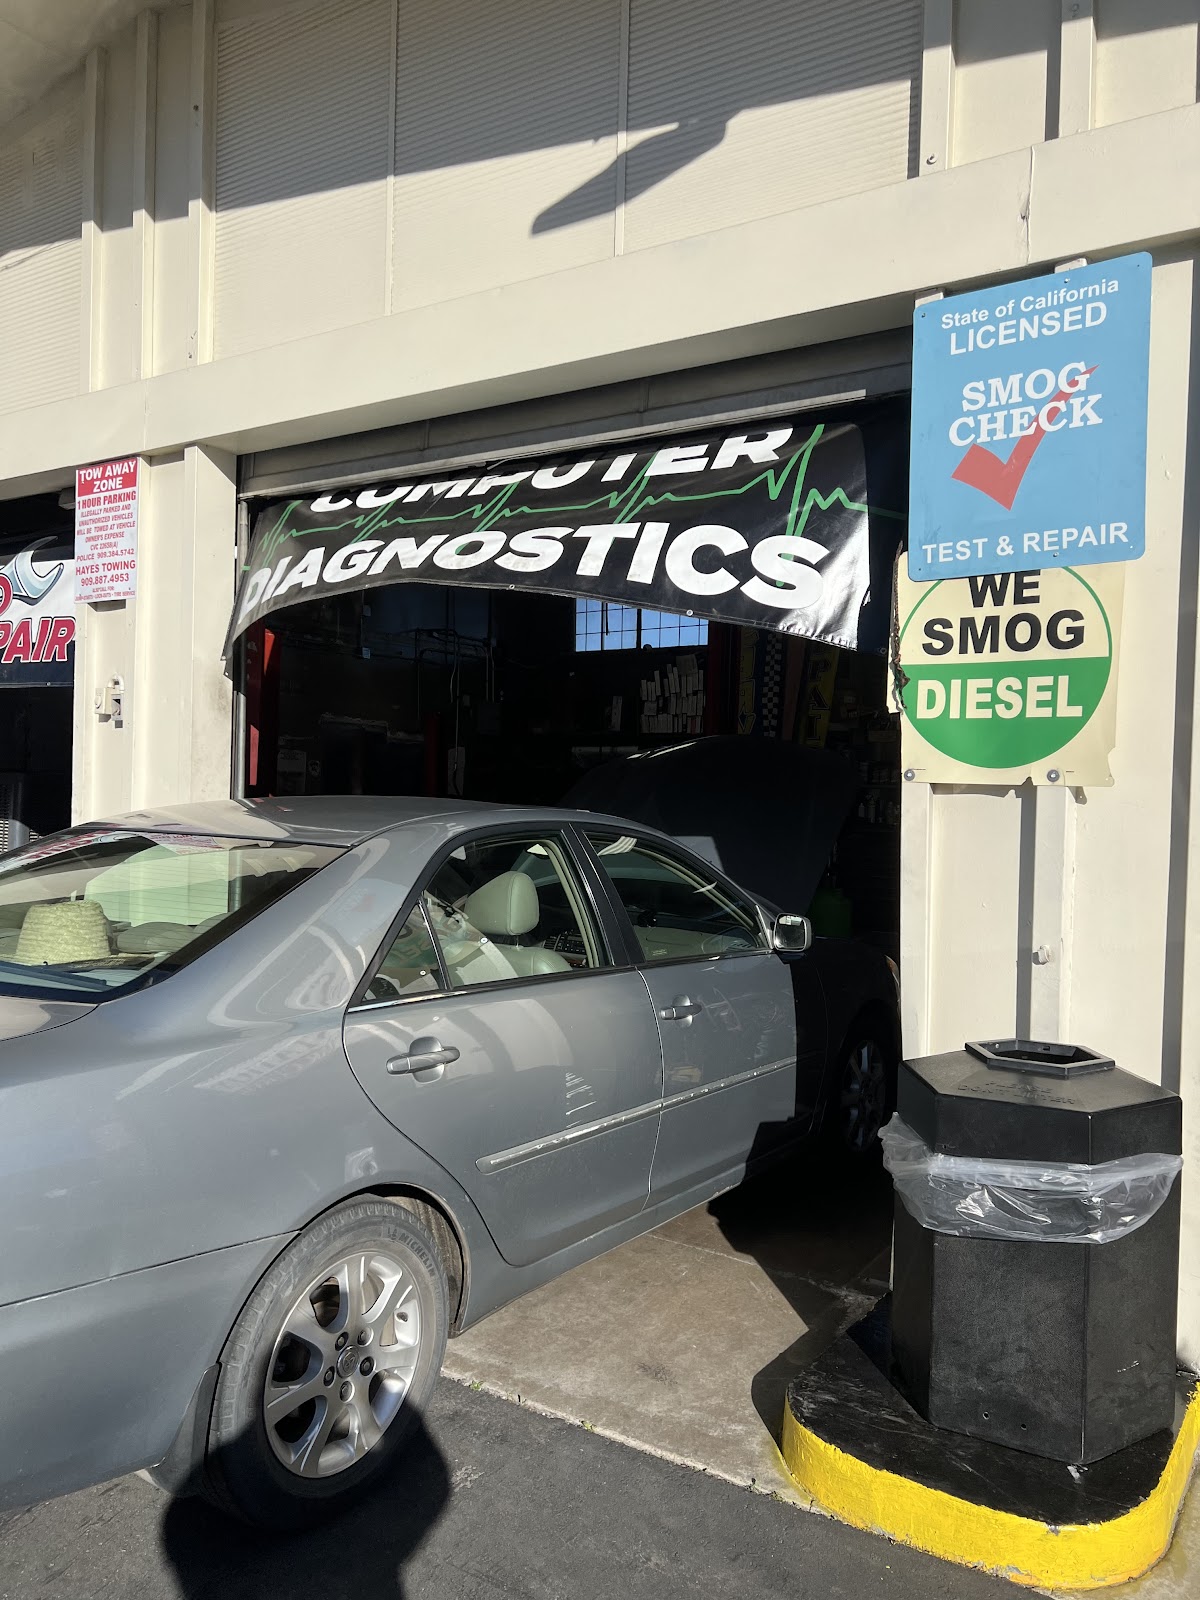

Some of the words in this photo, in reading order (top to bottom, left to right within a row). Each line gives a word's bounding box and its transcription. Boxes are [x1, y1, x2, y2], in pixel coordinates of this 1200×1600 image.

[941, 309, 989, 329] State
[995, 300, 1015, 319] of
[1020, 279, 1119, 312] California
[950, 301, 1107, 355] LICENSED
[962, 361, 1090, 412] SMOG
[949, 394, 1103, 446] CHECK
[80, 467, 103, 481] TOW
[105, 460, 137, 478] AWAY
[93, 477, 123, 493] ZONE
[310, 424, 794, 514] COMPUTER
[77, 500, 81, 510] 1
[82, 496, 102, 510] HOUR
[103, 490, 137, 506] PARKING
[78, 515, 111, 527] UNAUTHORIZED
[111, 512, 134, 522] VEHICLES
[80, 508, 102, 518] ILLEGALLY
[103, 505, 121, 514] PARKED
[121, 503, 131, 511] AND
[94, 524, 109, 533] TOWED
[110, 523, 116, 531] AT
[116, 520, 136, 530] VEHICLE
[104, 530, 125, 540] EXPENSE
[921, 538, 989, 564] TEST
[996, 535, 1015, 557] &
[1023, 521, 1130, 554] REPAIR
[75, 563, 100, 576] HAYES
[101, 559, 136, 572] TOWING
[76, 553, 95, 562] POLICE
[237, 521, 831, 625] DIAGNOSTICS
[80, 572, 130, 587] 909.887.4953
[968, 568, 1042, 608] WE
[921, 609, 1085, 656] SMOG
[916, 675, 1084, 719] DIESEL
[398, 1232, 437, 1278] MICHELIN
